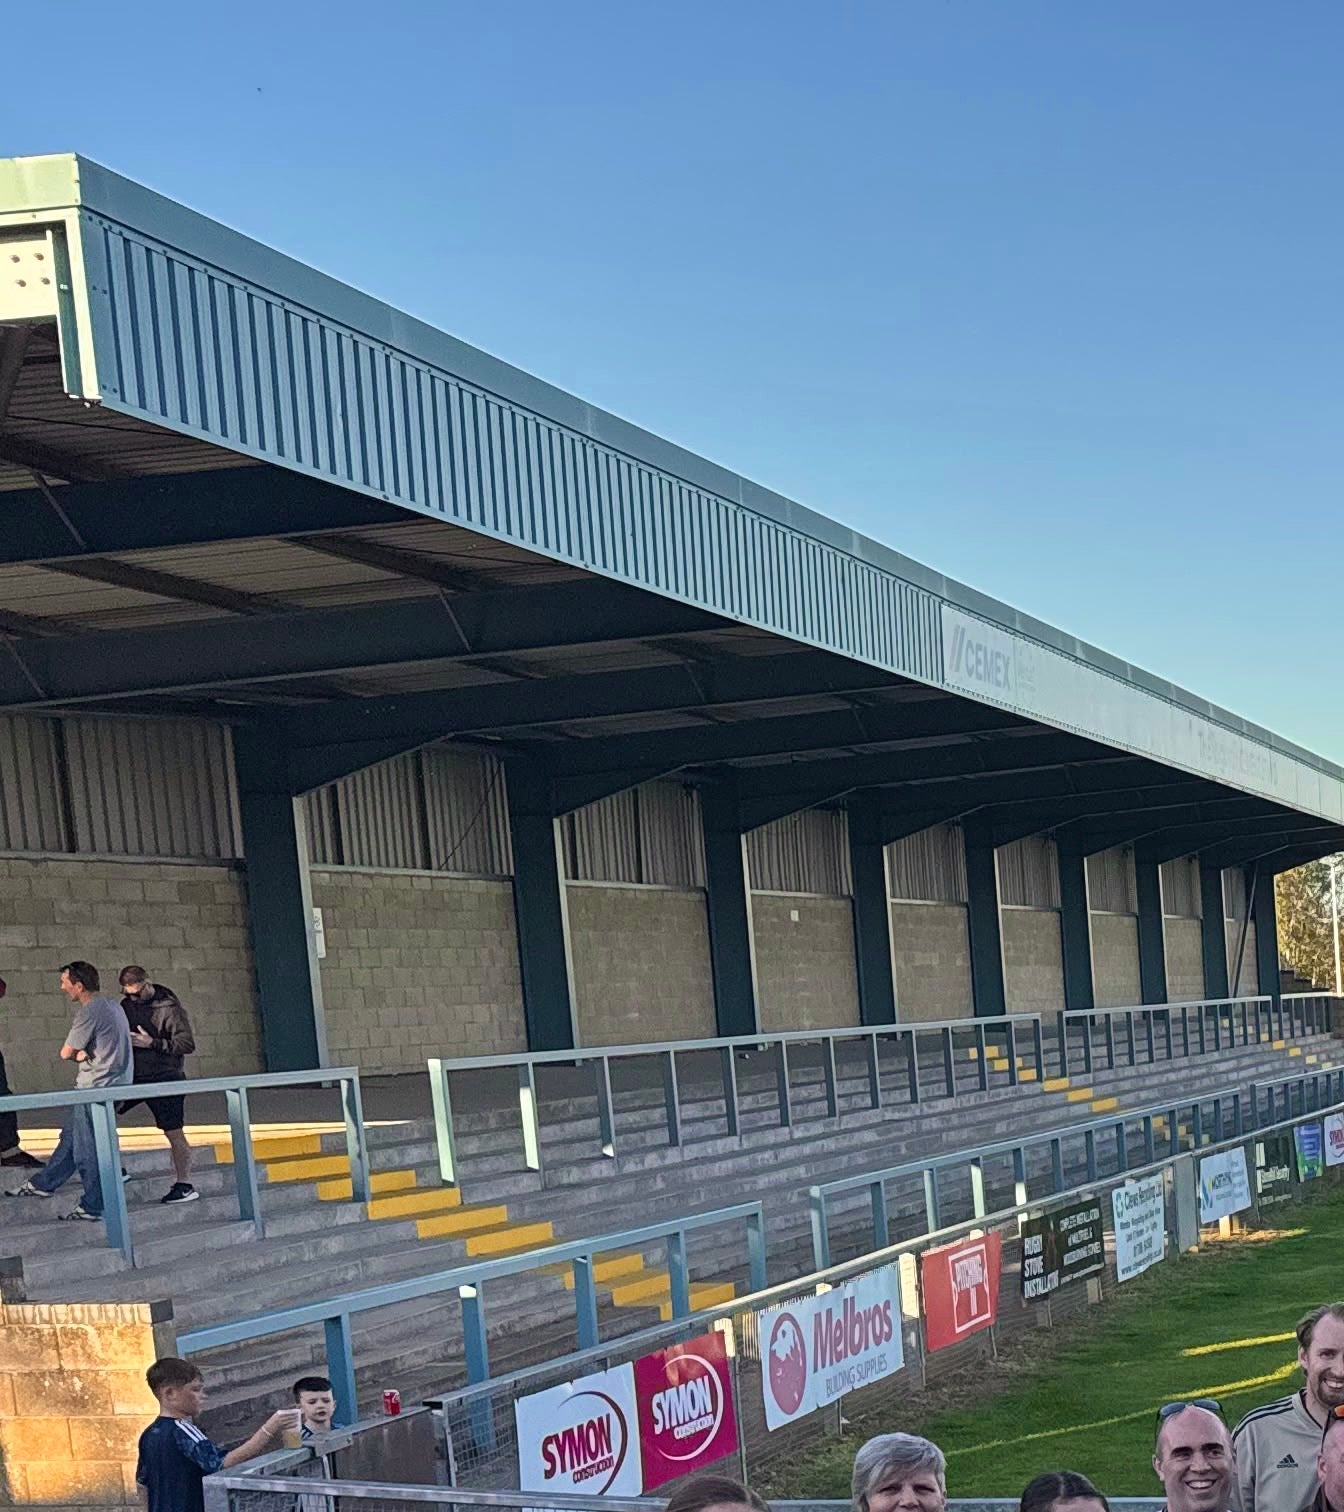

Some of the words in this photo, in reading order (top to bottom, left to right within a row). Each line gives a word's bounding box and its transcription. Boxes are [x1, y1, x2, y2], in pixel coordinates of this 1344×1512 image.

[965, 639, 1011, 692] CEMEX
[813, 1295, 893, 1375] Melbros
[651, 1375, 713, 1436] SYMON
[825, 1366, 855, 1398] BUILDING
[856, 1353, 888, 1382] SUPPLIES
[541, 1413, 613, 1480] SYMON
